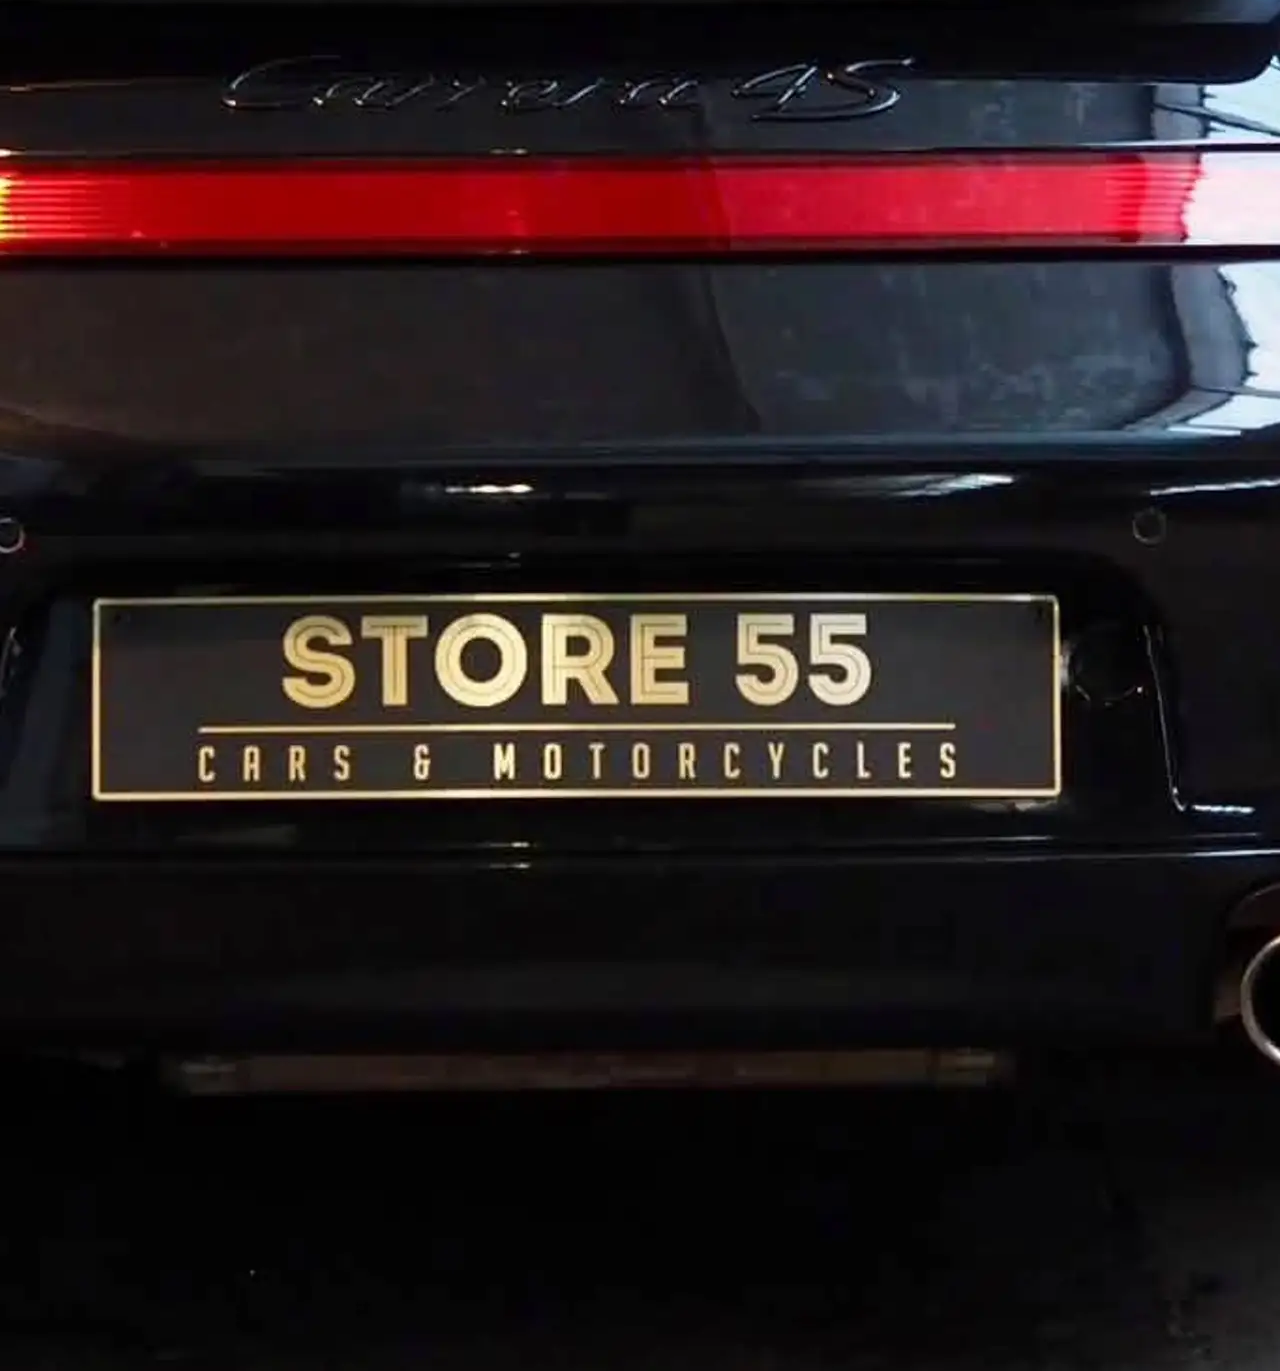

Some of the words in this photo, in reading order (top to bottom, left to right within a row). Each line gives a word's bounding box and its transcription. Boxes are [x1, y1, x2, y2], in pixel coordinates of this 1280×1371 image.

[219, 54, 706, 112] Carrera
[732, 56, 917, 122] 4S
[281, 612, 691, 709] STORE
[734, 612, 873, 707] 55
[197, 743, 352, 782] CARS
[412, 743, 433, 781] &
[492, 740, 957, 782] MOTORCYCLES
